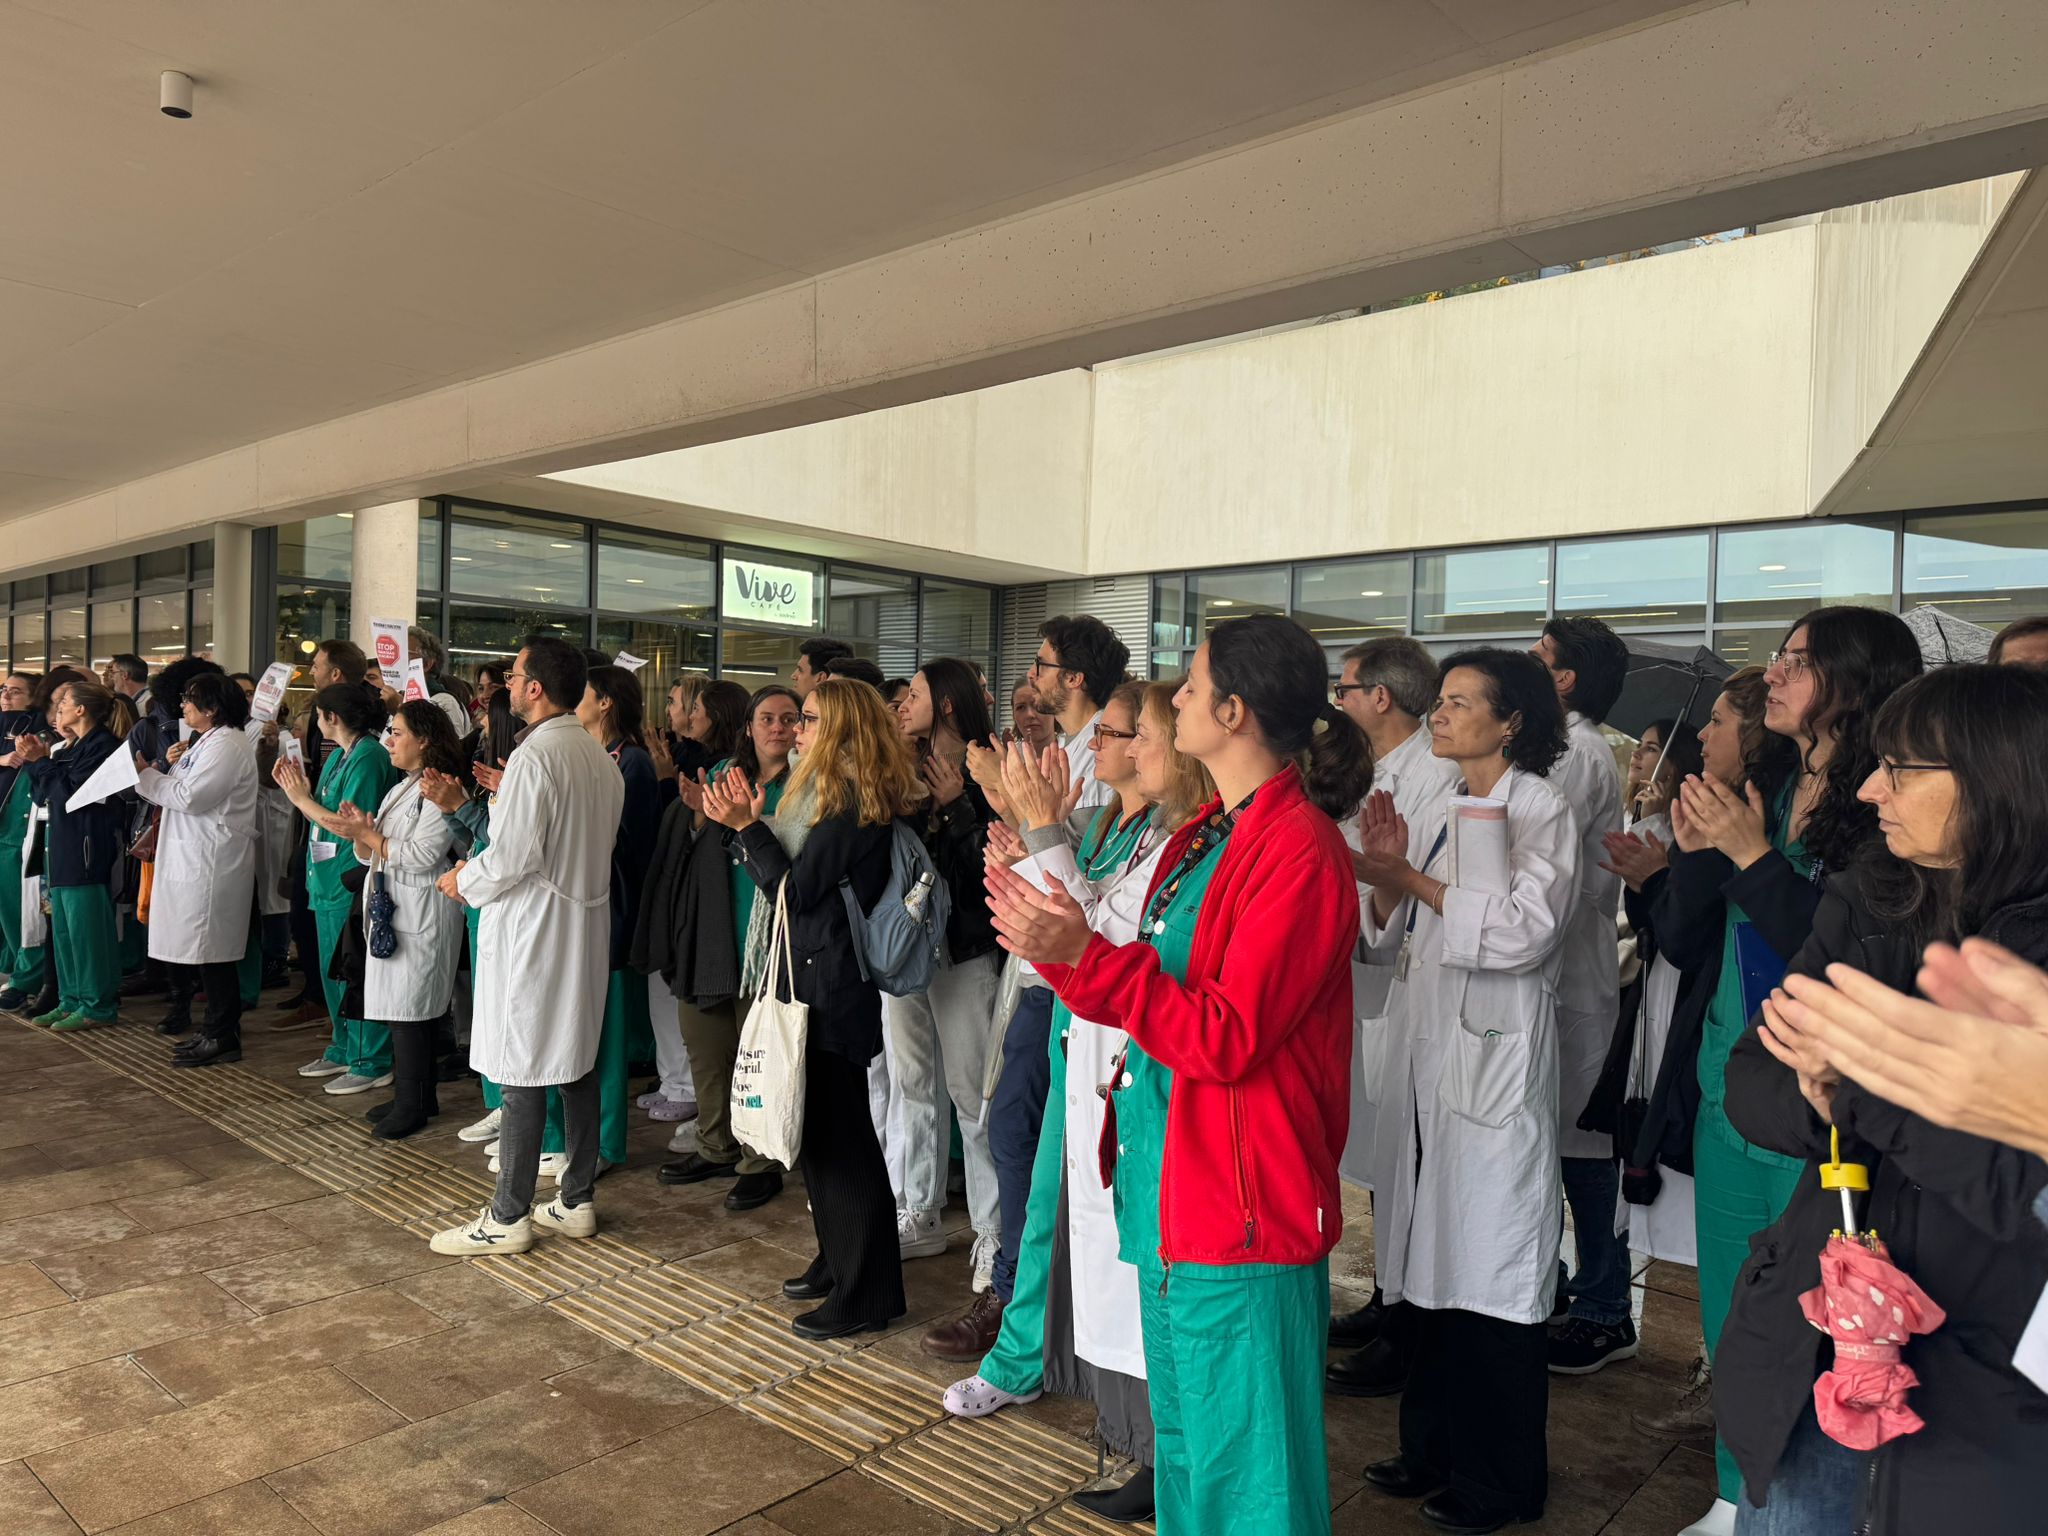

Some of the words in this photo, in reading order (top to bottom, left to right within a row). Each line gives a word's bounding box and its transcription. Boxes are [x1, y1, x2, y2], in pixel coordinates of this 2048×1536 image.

[735, 565, 796, 604] Vive
[377, 643, 395, 651] STOP
[406, 687, 418, 695] STOP
